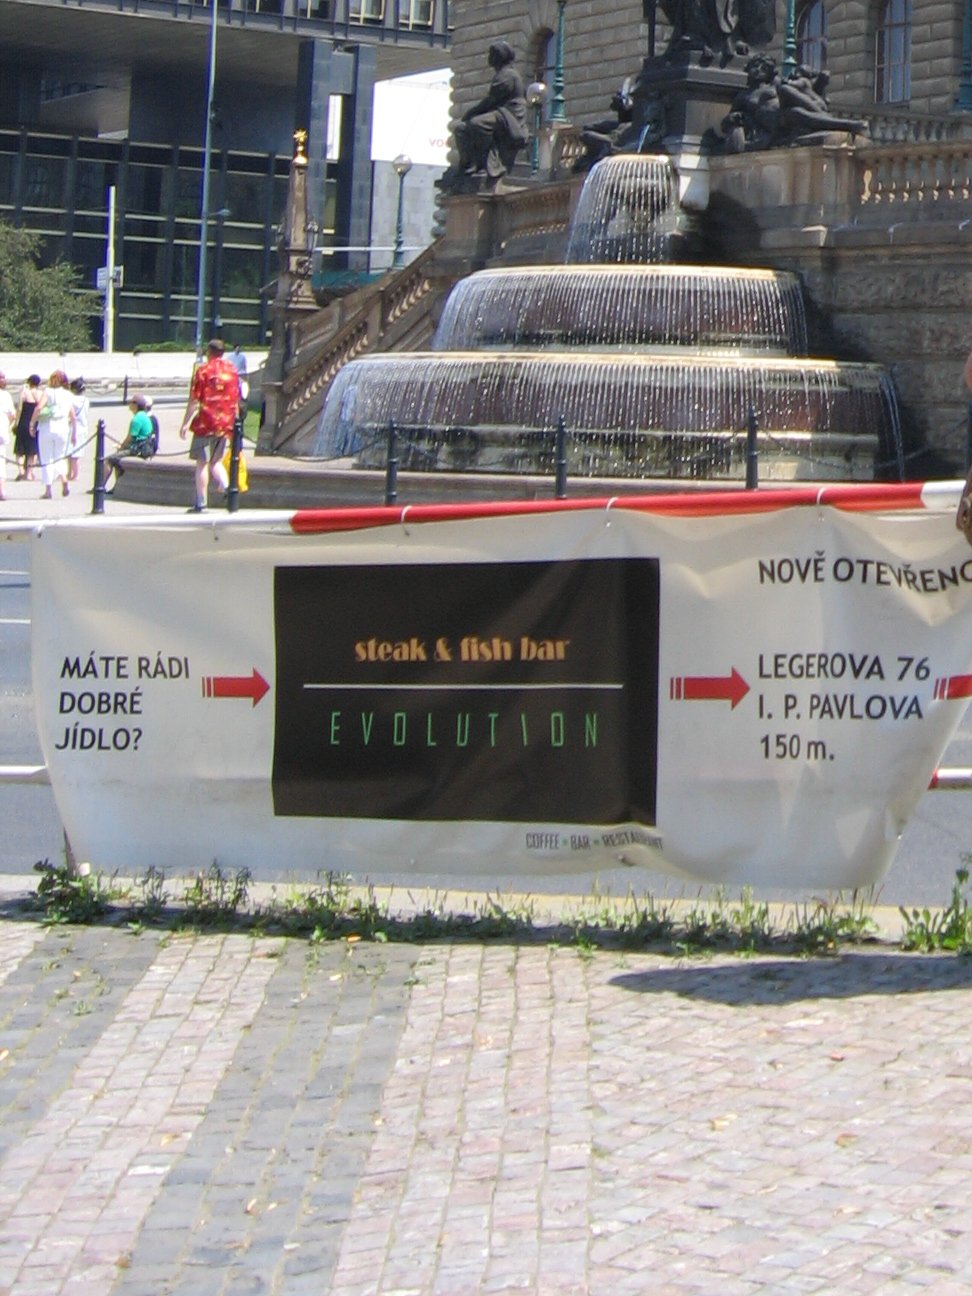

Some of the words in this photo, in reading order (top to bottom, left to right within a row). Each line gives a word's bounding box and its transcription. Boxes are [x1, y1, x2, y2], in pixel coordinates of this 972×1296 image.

[758, 550, 825, 584] NOVĚ
[354, 637, 427, 662] steak
[433, 637, 452, 662] &
[459, 636, 512, 662] fish
[519, 636, 571, 662] bar
[60, 650, 129, 679] MÁTE
[138, 651, 190, 679] RÁDI
[758, 653, 885, 681] LEGEROVA
[897, 656, 931, 682] 76
[59, 686, 143, 715] DOBRÉ
[758, 694, 773, 719] I.
[784, 694, 801, 719] P.
[809, 694, 924, 720] PAVLOVA
[55, 722, 143, 751] JÍDLO?
[329, 711, 597, 747] EVOLUTION
[760, 734, 801, 759] 150
[806, 740, 835, 761] m.
[525, 833, 560, 850] COFFEE
[570, 835, 591, 851] BAR
